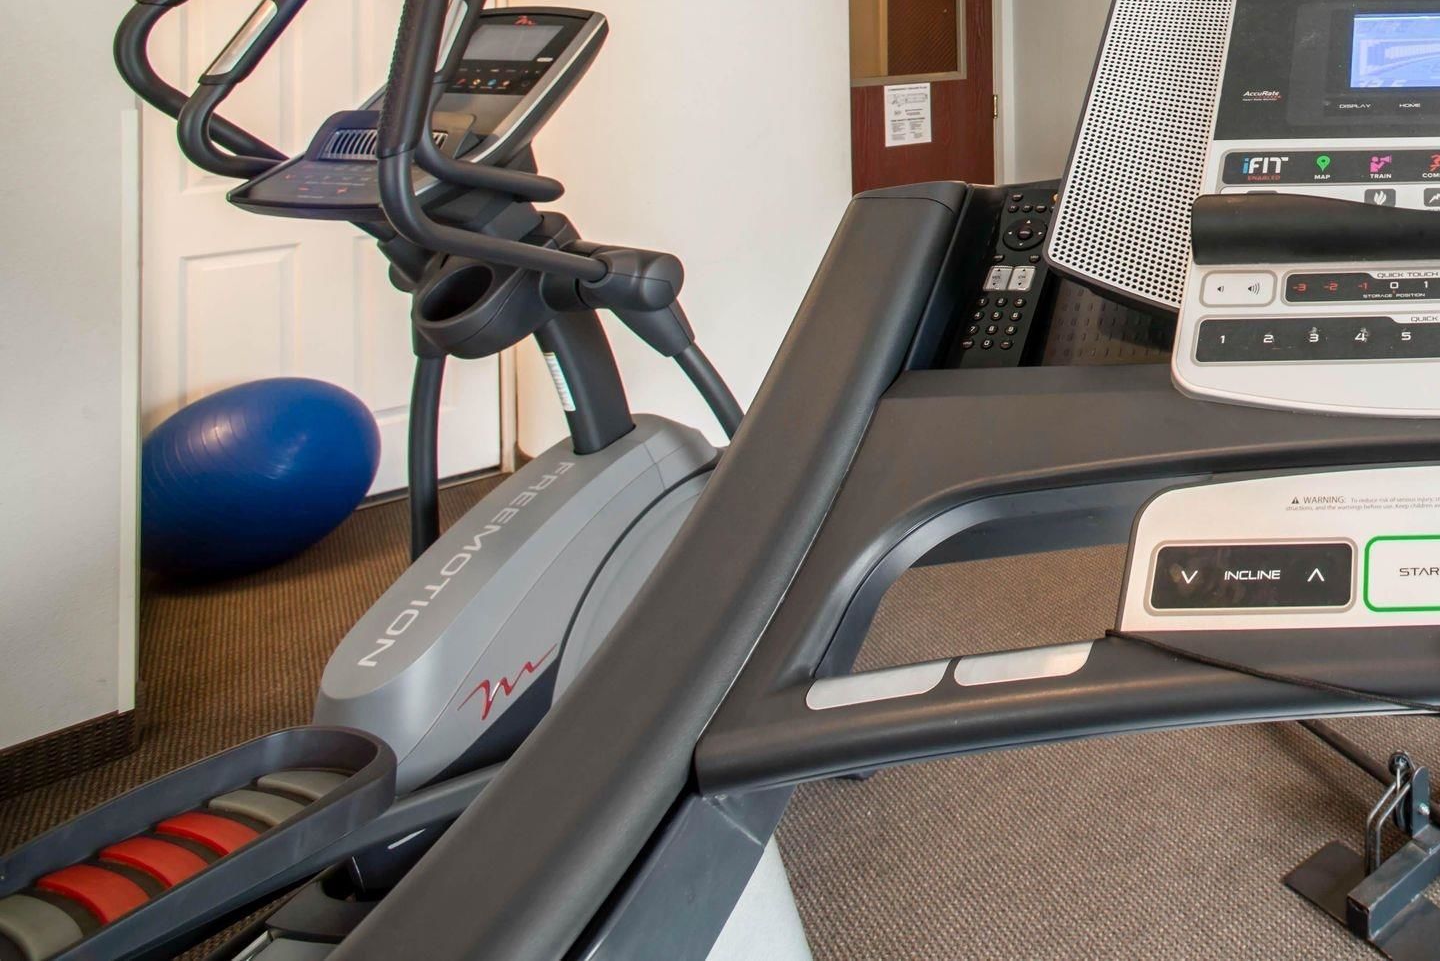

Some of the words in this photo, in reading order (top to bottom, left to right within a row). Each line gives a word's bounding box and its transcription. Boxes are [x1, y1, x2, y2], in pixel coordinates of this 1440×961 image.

[1242, 157, 1289, 175] iFIT
[1424, 280, 1429, 288] 1
[1220, 335, 1226, 344] 1
[1264, 334, 1274, 344] 2
[1309, 334, 1319, 342] 3
[1355, 333, 1366, 342] 4
[1401, 332, 1412, 340] 5
[1303, 496, 1346, 504] WARNING:
[357, 462, 575, 667] FREEMOTION
[1224, 570, 1281, 580] INCLINE
